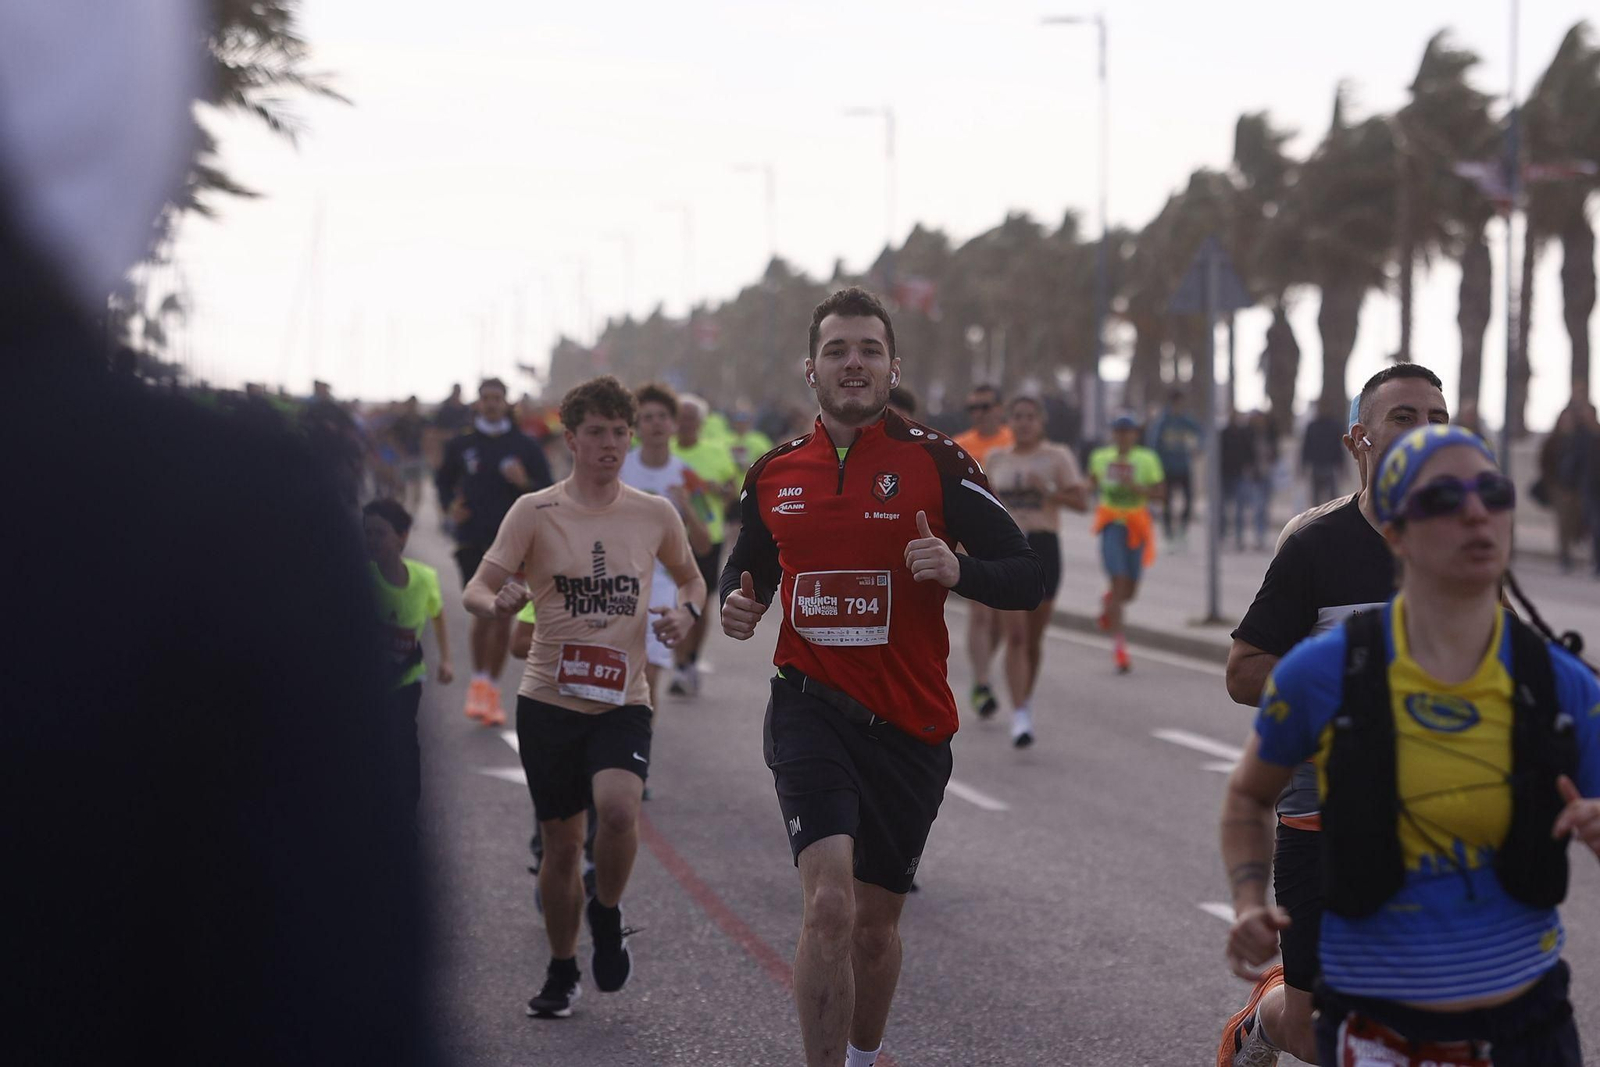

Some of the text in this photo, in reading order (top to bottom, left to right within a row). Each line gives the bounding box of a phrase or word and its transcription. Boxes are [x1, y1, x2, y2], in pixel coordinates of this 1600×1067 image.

[777, 487, 803, 498] JAKO
[873, 512, 900, 521] Metzger
[553, 575, 639, 597] BRUNCH
[564, 594, 607, 618] RUN
[797, 595, 838, 607] BRUNCH
[844, 597, 879, 615] 794
[801, 605, 822, 617] RUN
[594, 664, 622, 681] 877
[789, 815, 802, 837] DM
